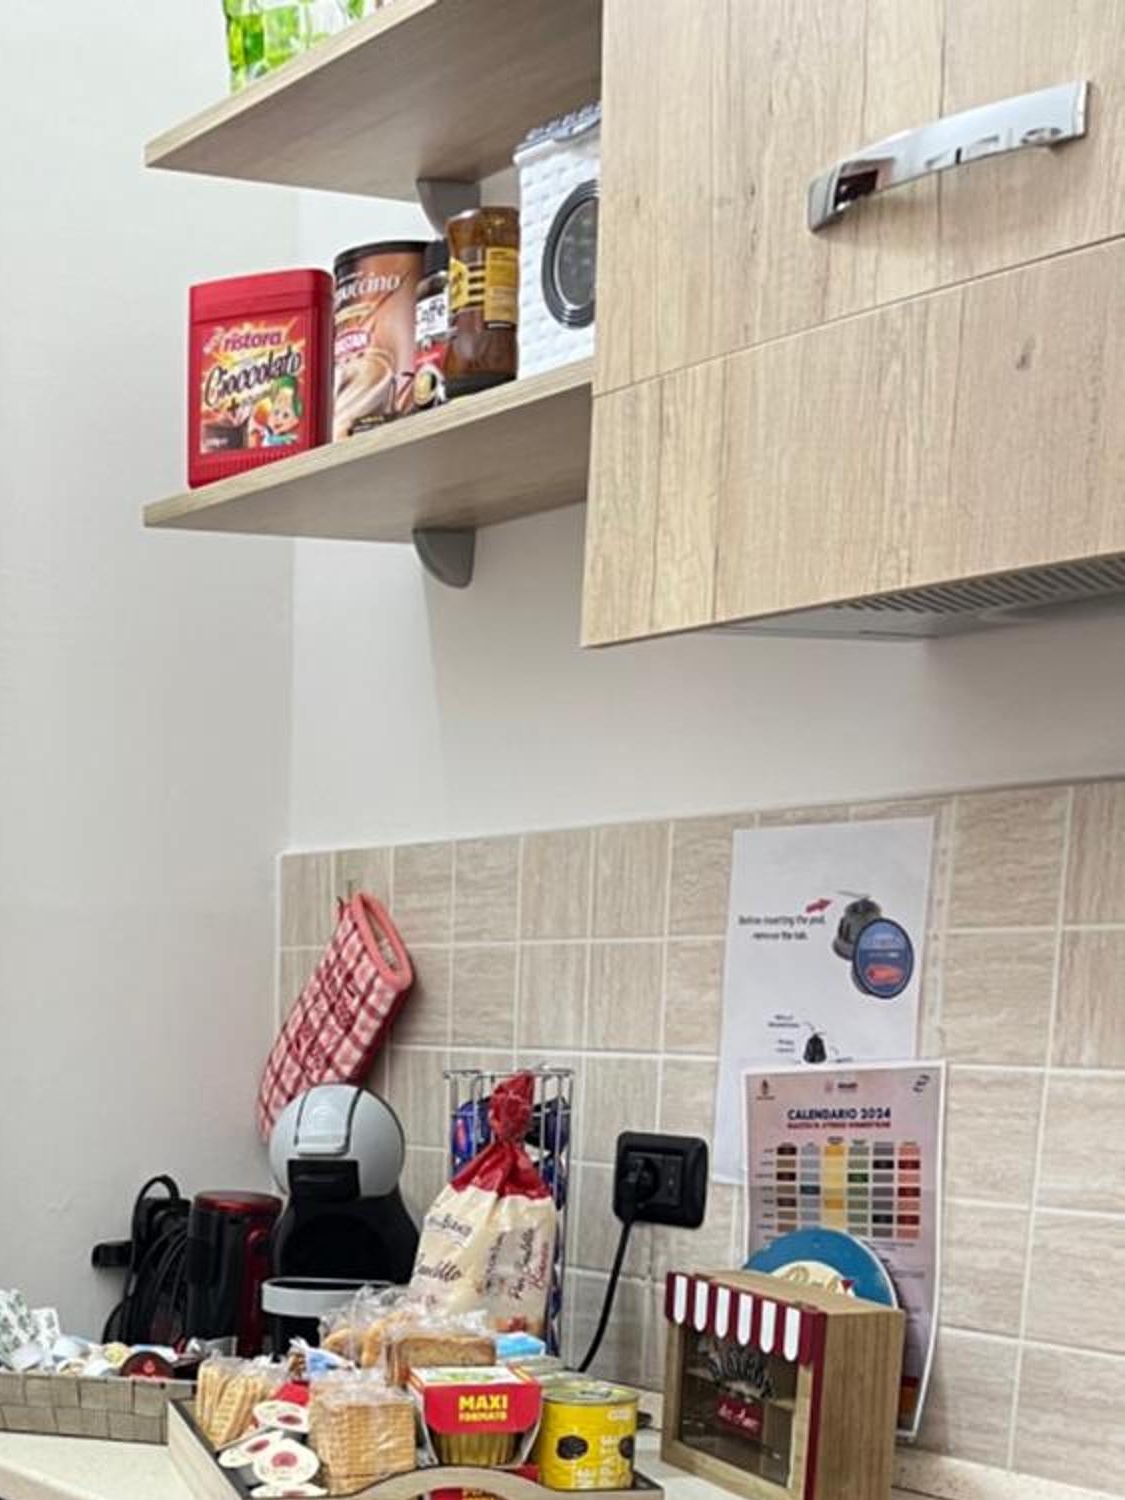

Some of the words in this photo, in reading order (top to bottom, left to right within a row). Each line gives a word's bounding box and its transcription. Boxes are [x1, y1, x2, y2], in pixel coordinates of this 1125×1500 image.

[787, 1108, 858, 1121] CALENDARIO
[861, 1107, 891, 1119] 2024
[459, 1394, 508, 1410] MAXI
[459, 1411, 508, 1422] FORMATO
